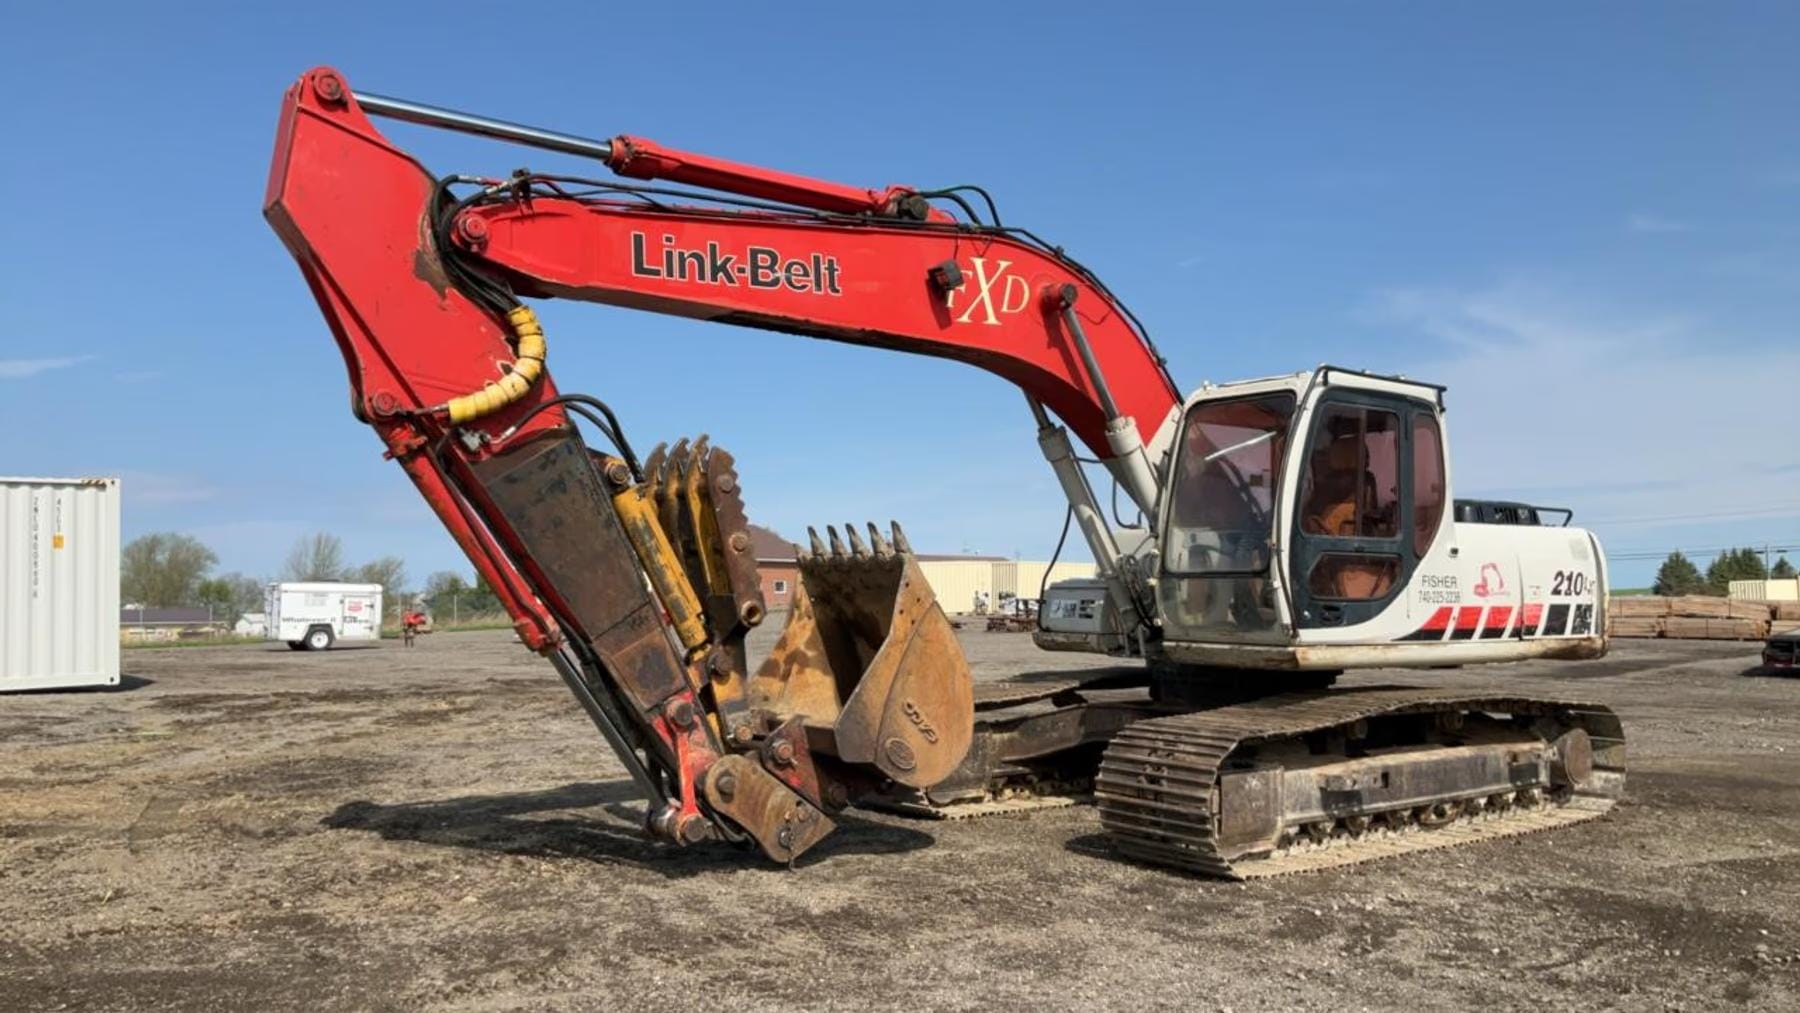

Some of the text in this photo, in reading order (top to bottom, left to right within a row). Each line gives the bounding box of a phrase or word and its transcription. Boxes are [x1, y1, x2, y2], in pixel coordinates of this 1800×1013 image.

[631, 231, 842, 297] Link-Belt
[1421, 575, 1457, 588] FISHER
[1551, 570, 1584, 596] 210
